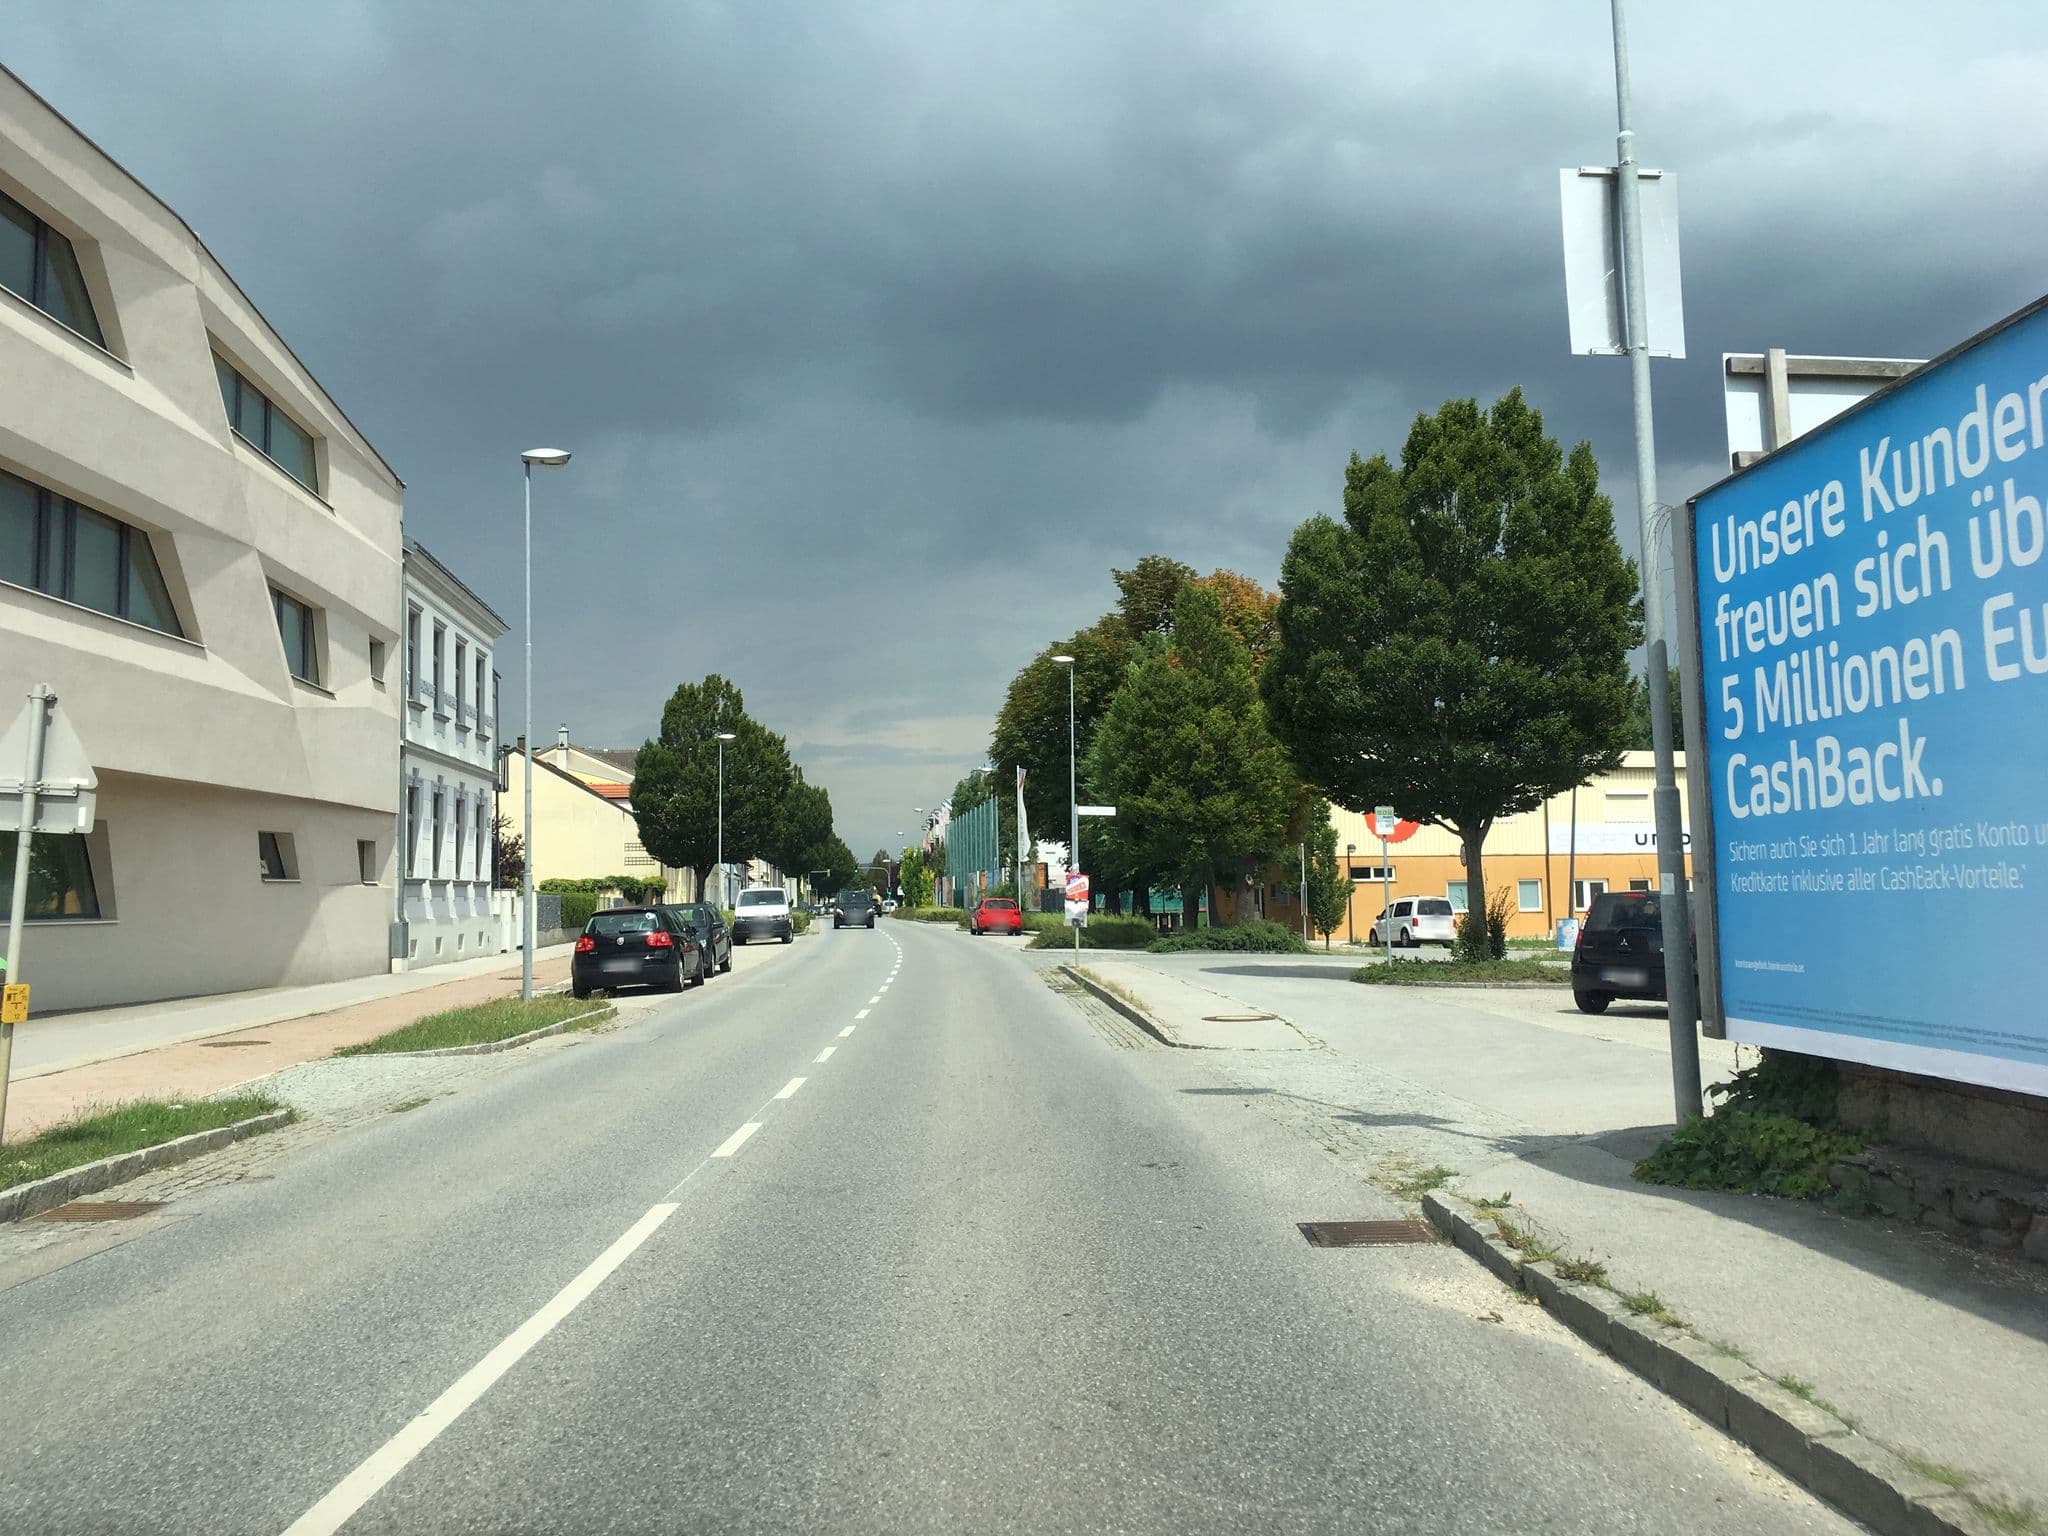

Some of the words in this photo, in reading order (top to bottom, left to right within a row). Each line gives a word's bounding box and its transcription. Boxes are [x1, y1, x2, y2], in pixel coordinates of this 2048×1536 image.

[1711, 479, 1846, 583] Unsere
[1715, 572, 1841, 662] freuen
[1855, 514, 1952, 618] sich
[1969, 477, 2048, 579] üb
[1721, 673, 1744, 741] 5
[1755, 628, 1965, 734] Millionen
[1726, 717, 1943, 819] CashBack.
[1729, 840, 1767, 862] Sichern
[1770, 836, 1797, 860] auch
[1800, 835, 1817, 858] Sie
[1820, 833, 1846, 857] sich
[1850, 832, 1858, 856] 1
[1862, 829, 1889, 855] Jahr
[1894, 827, 1925, 857] lang
[1929, 822, 1973, 857] gratis
[1977, 820, 2029, 847] Konto
[2034, 822, 2048, 845] u
[1731, 871, 1789, 893] Kreditkarte
[1791, 868, 1844, 892] inklusive
[1847, 866, 1876, 891] aller
